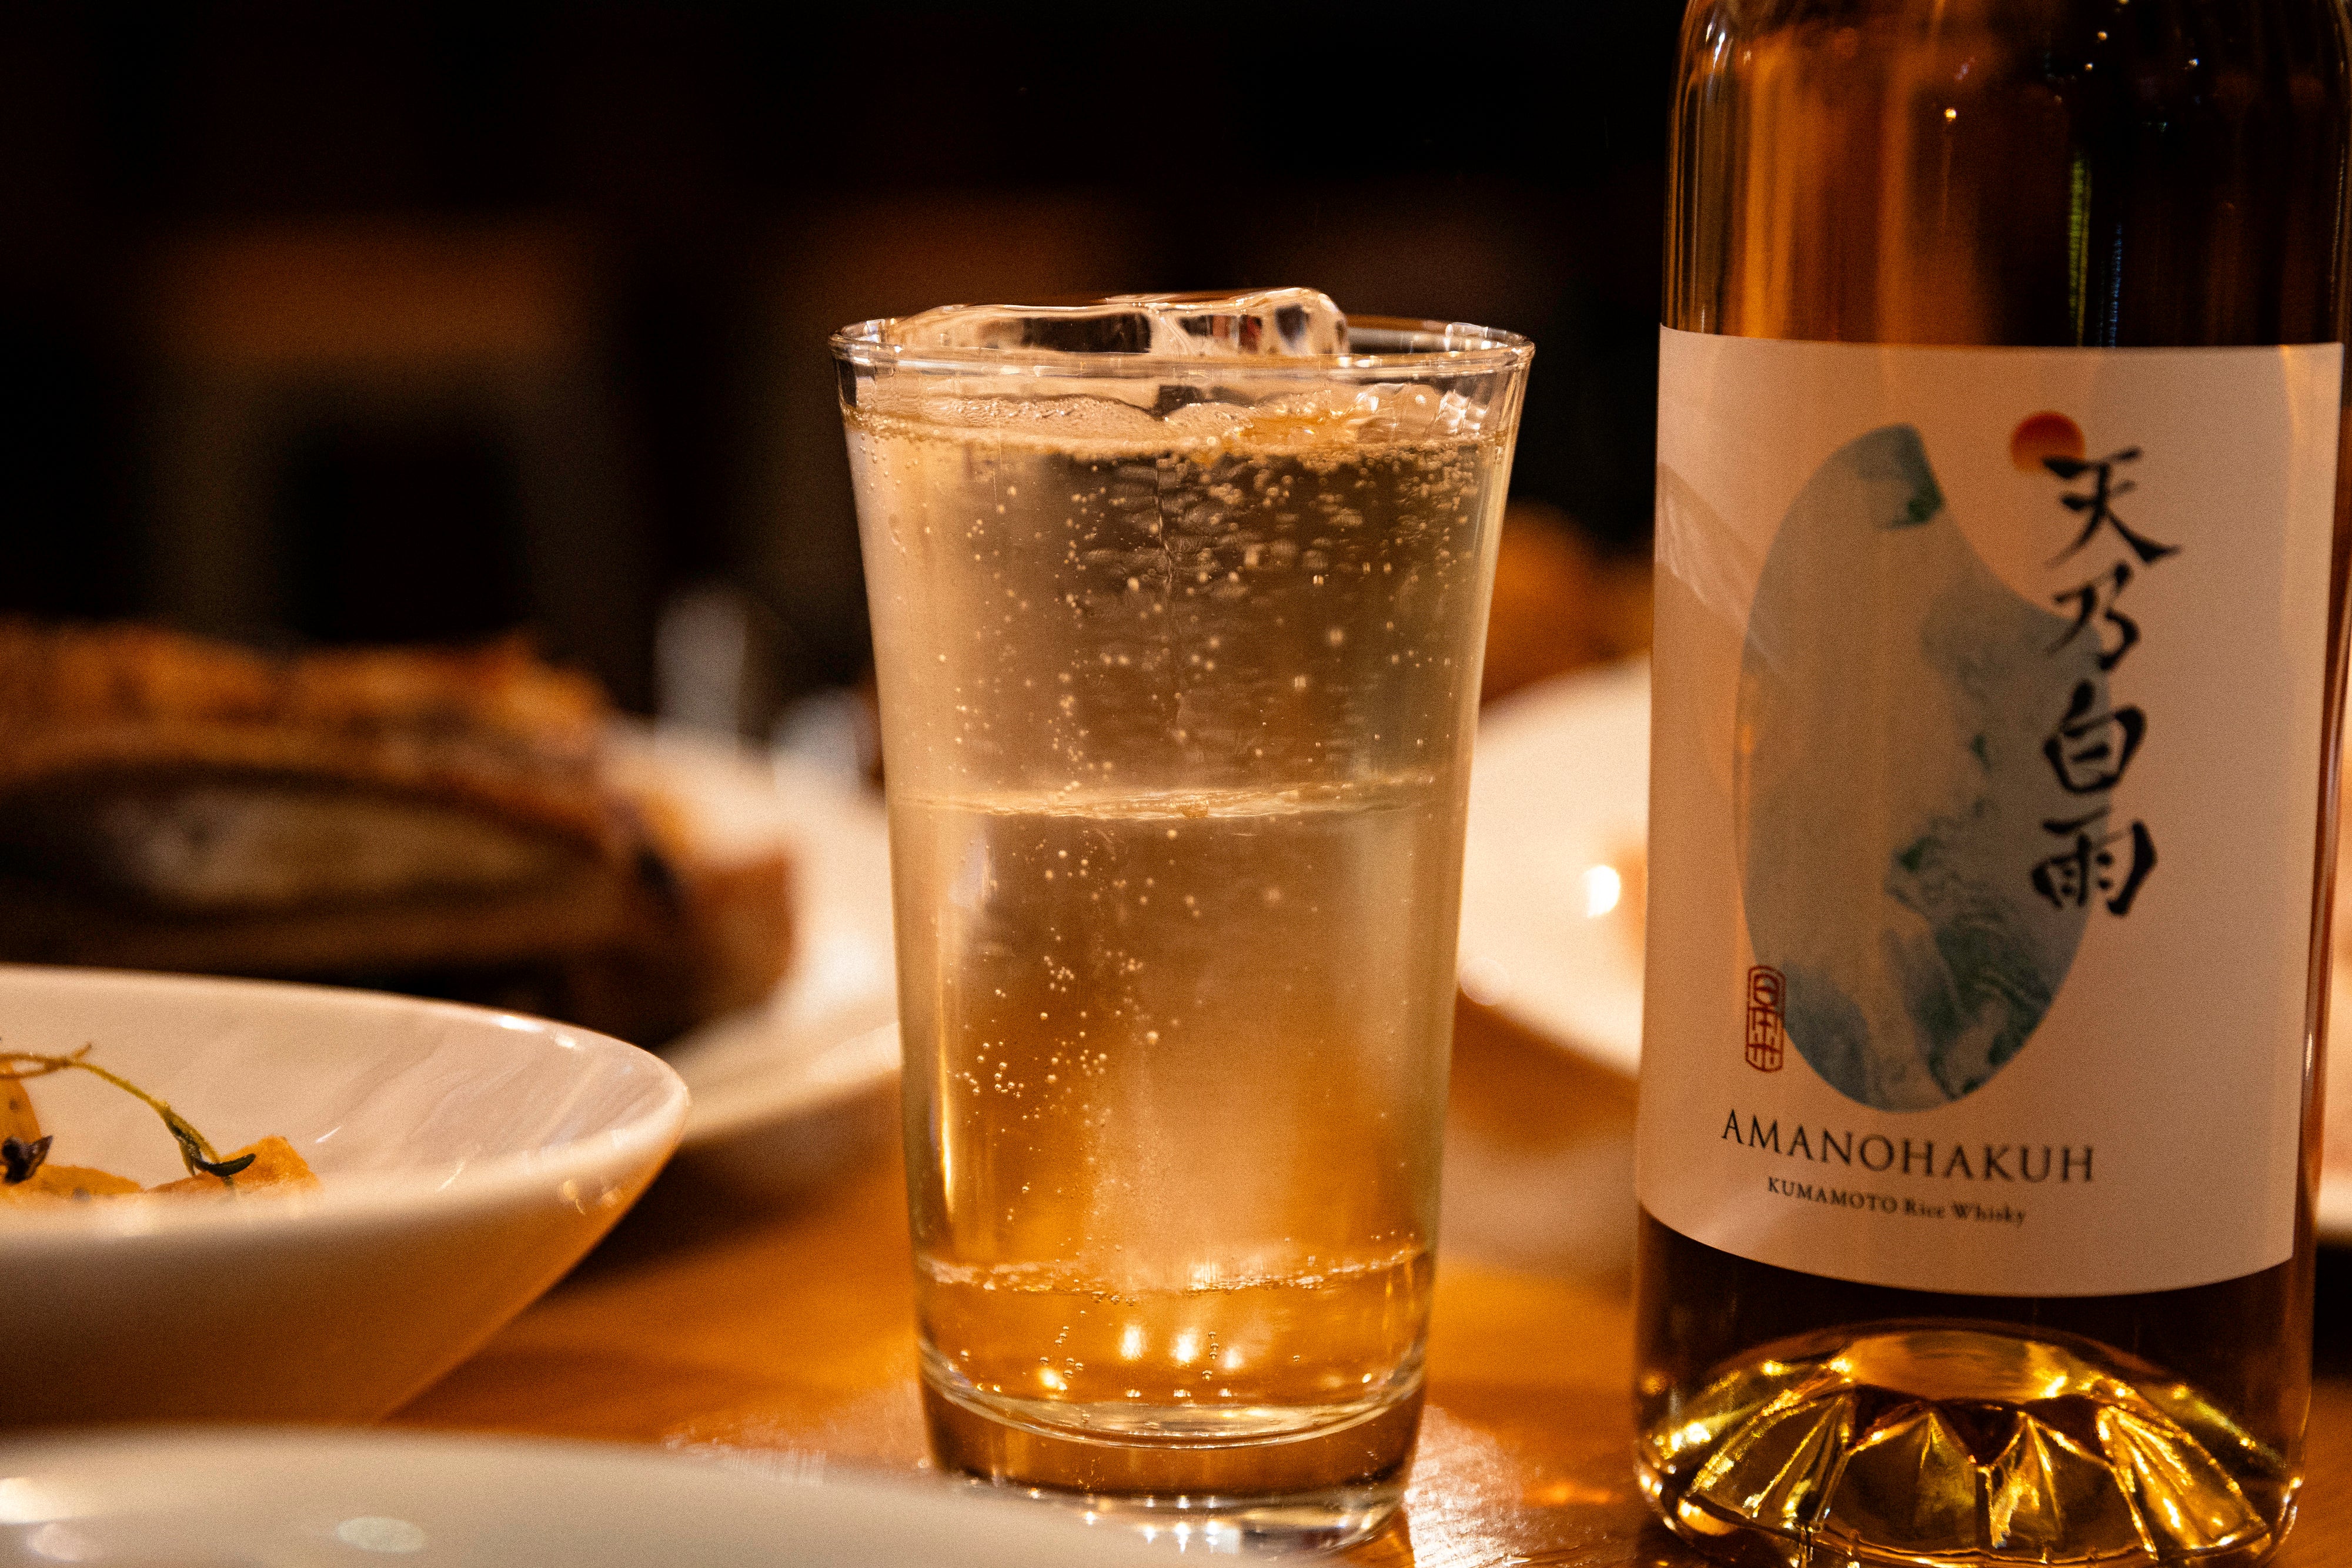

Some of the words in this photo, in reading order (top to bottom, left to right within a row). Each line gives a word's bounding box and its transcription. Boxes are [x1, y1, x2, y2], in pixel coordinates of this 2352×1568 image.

[2030, 446, 2183, 916] 天乃白雨
[1720, 1108, 2096, 1183] AMANOHAKUH
[1766, 1176, 1899, 1215] KUMAMOTO
[1903, 1201, 1945, 1221] Rice
[1950, 1203, 2026, 1229] Whisky
